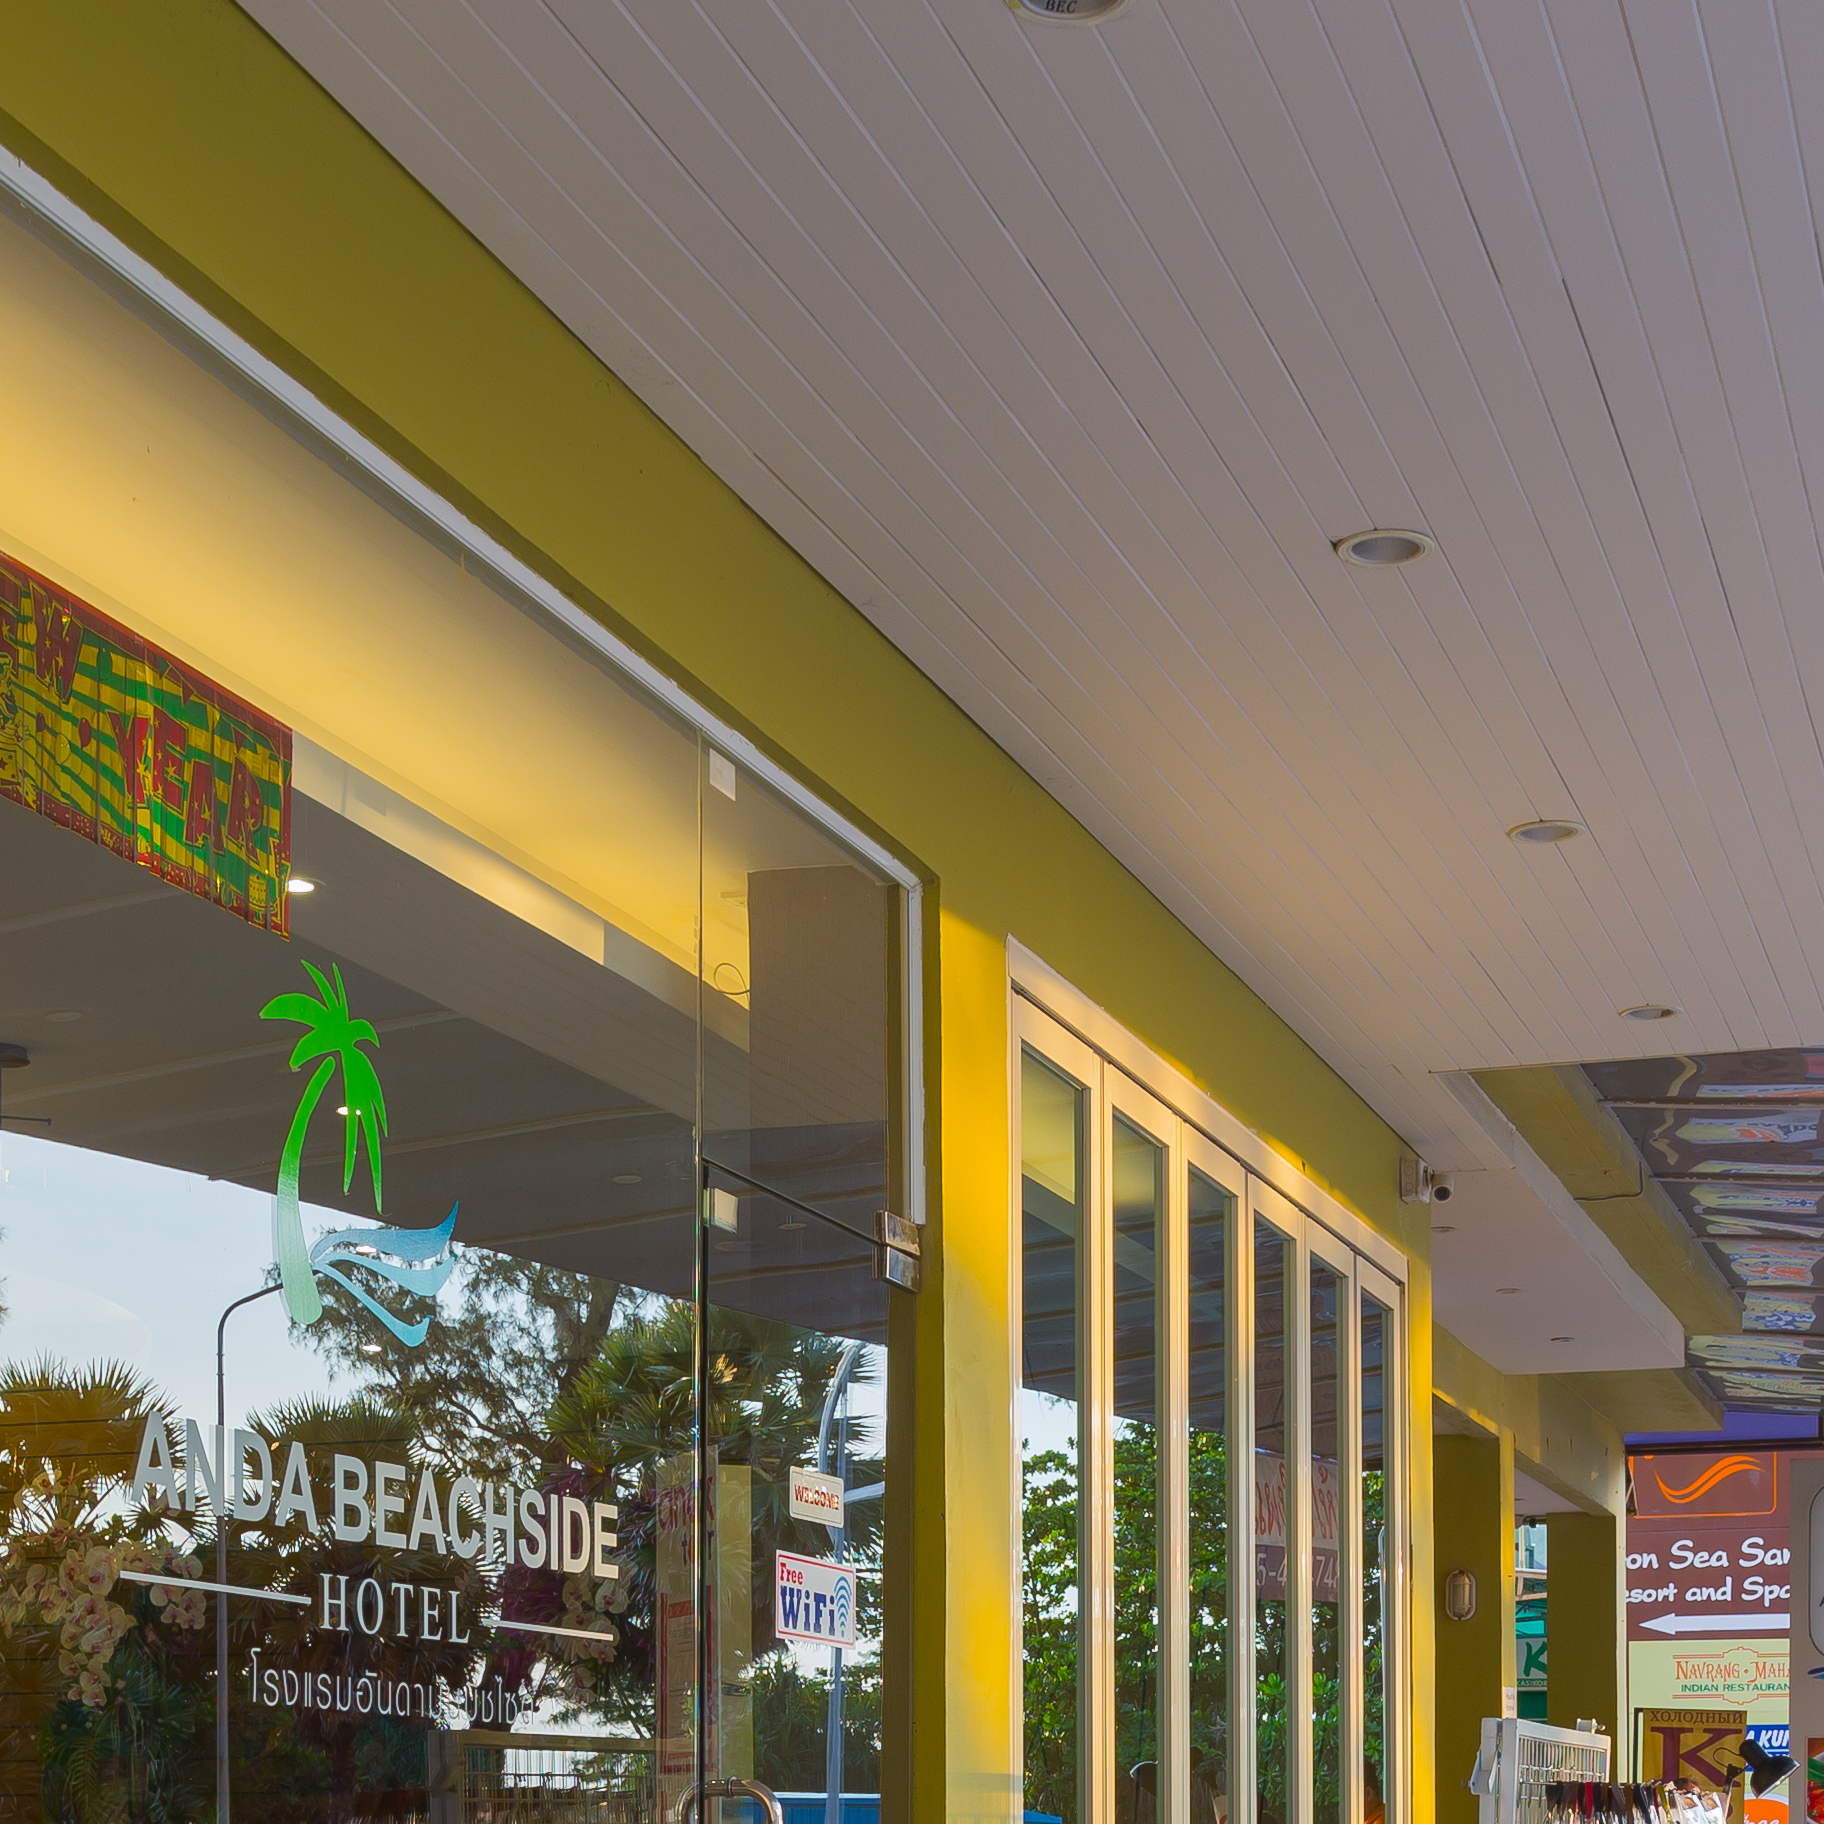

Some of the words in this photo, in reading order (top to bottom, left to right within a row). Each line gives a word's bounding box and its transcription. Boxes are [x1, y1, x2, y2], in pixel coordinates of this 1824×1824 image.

[105, 703, 264, 866] YEAR
[131, 1411, 318, 1534] ANDA
[333, 1454, 620, 1580] BEACHSIDE
[794, 1484, 840, 1511] WELCOME
[1668, 1539, 1730, 1570] Sea
[779, 1561, 803, 1586] Free
[1685, 1575, 1733, 1602] and
[320, 1572, 472, 1645] HOTEL
[780, 1584, 836, 1637] WiFi
[1675, 1660, 1741, 1682] NAVRANG
[1681, 1683, 1719, 1692] INDIAN
[1649, 1710, 1744, 1725] ХОЛОДНЫЙ
